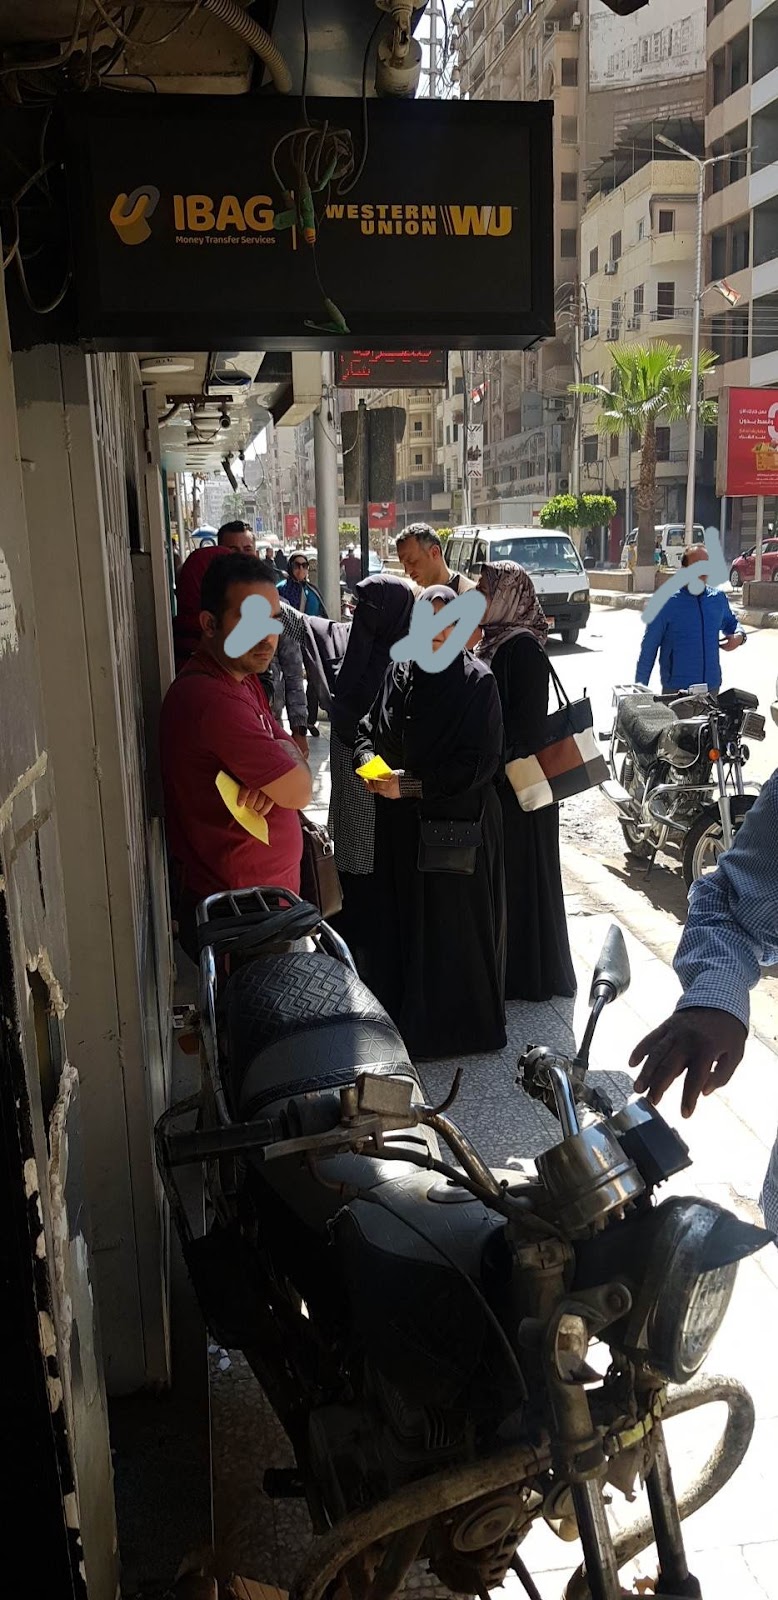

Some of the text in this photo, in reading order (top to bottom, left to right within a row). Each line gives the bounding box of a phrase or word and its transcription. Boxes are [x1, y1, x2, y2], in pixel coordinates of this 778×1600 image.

[173, 194, 275, 232] IBAG
[325, 204, 436, 219] WESTERN
[361, 220, 436, 235] UNION
[450, 205, 513, 237] WU
[175, 235, 276, 245] Money Transfer Services
